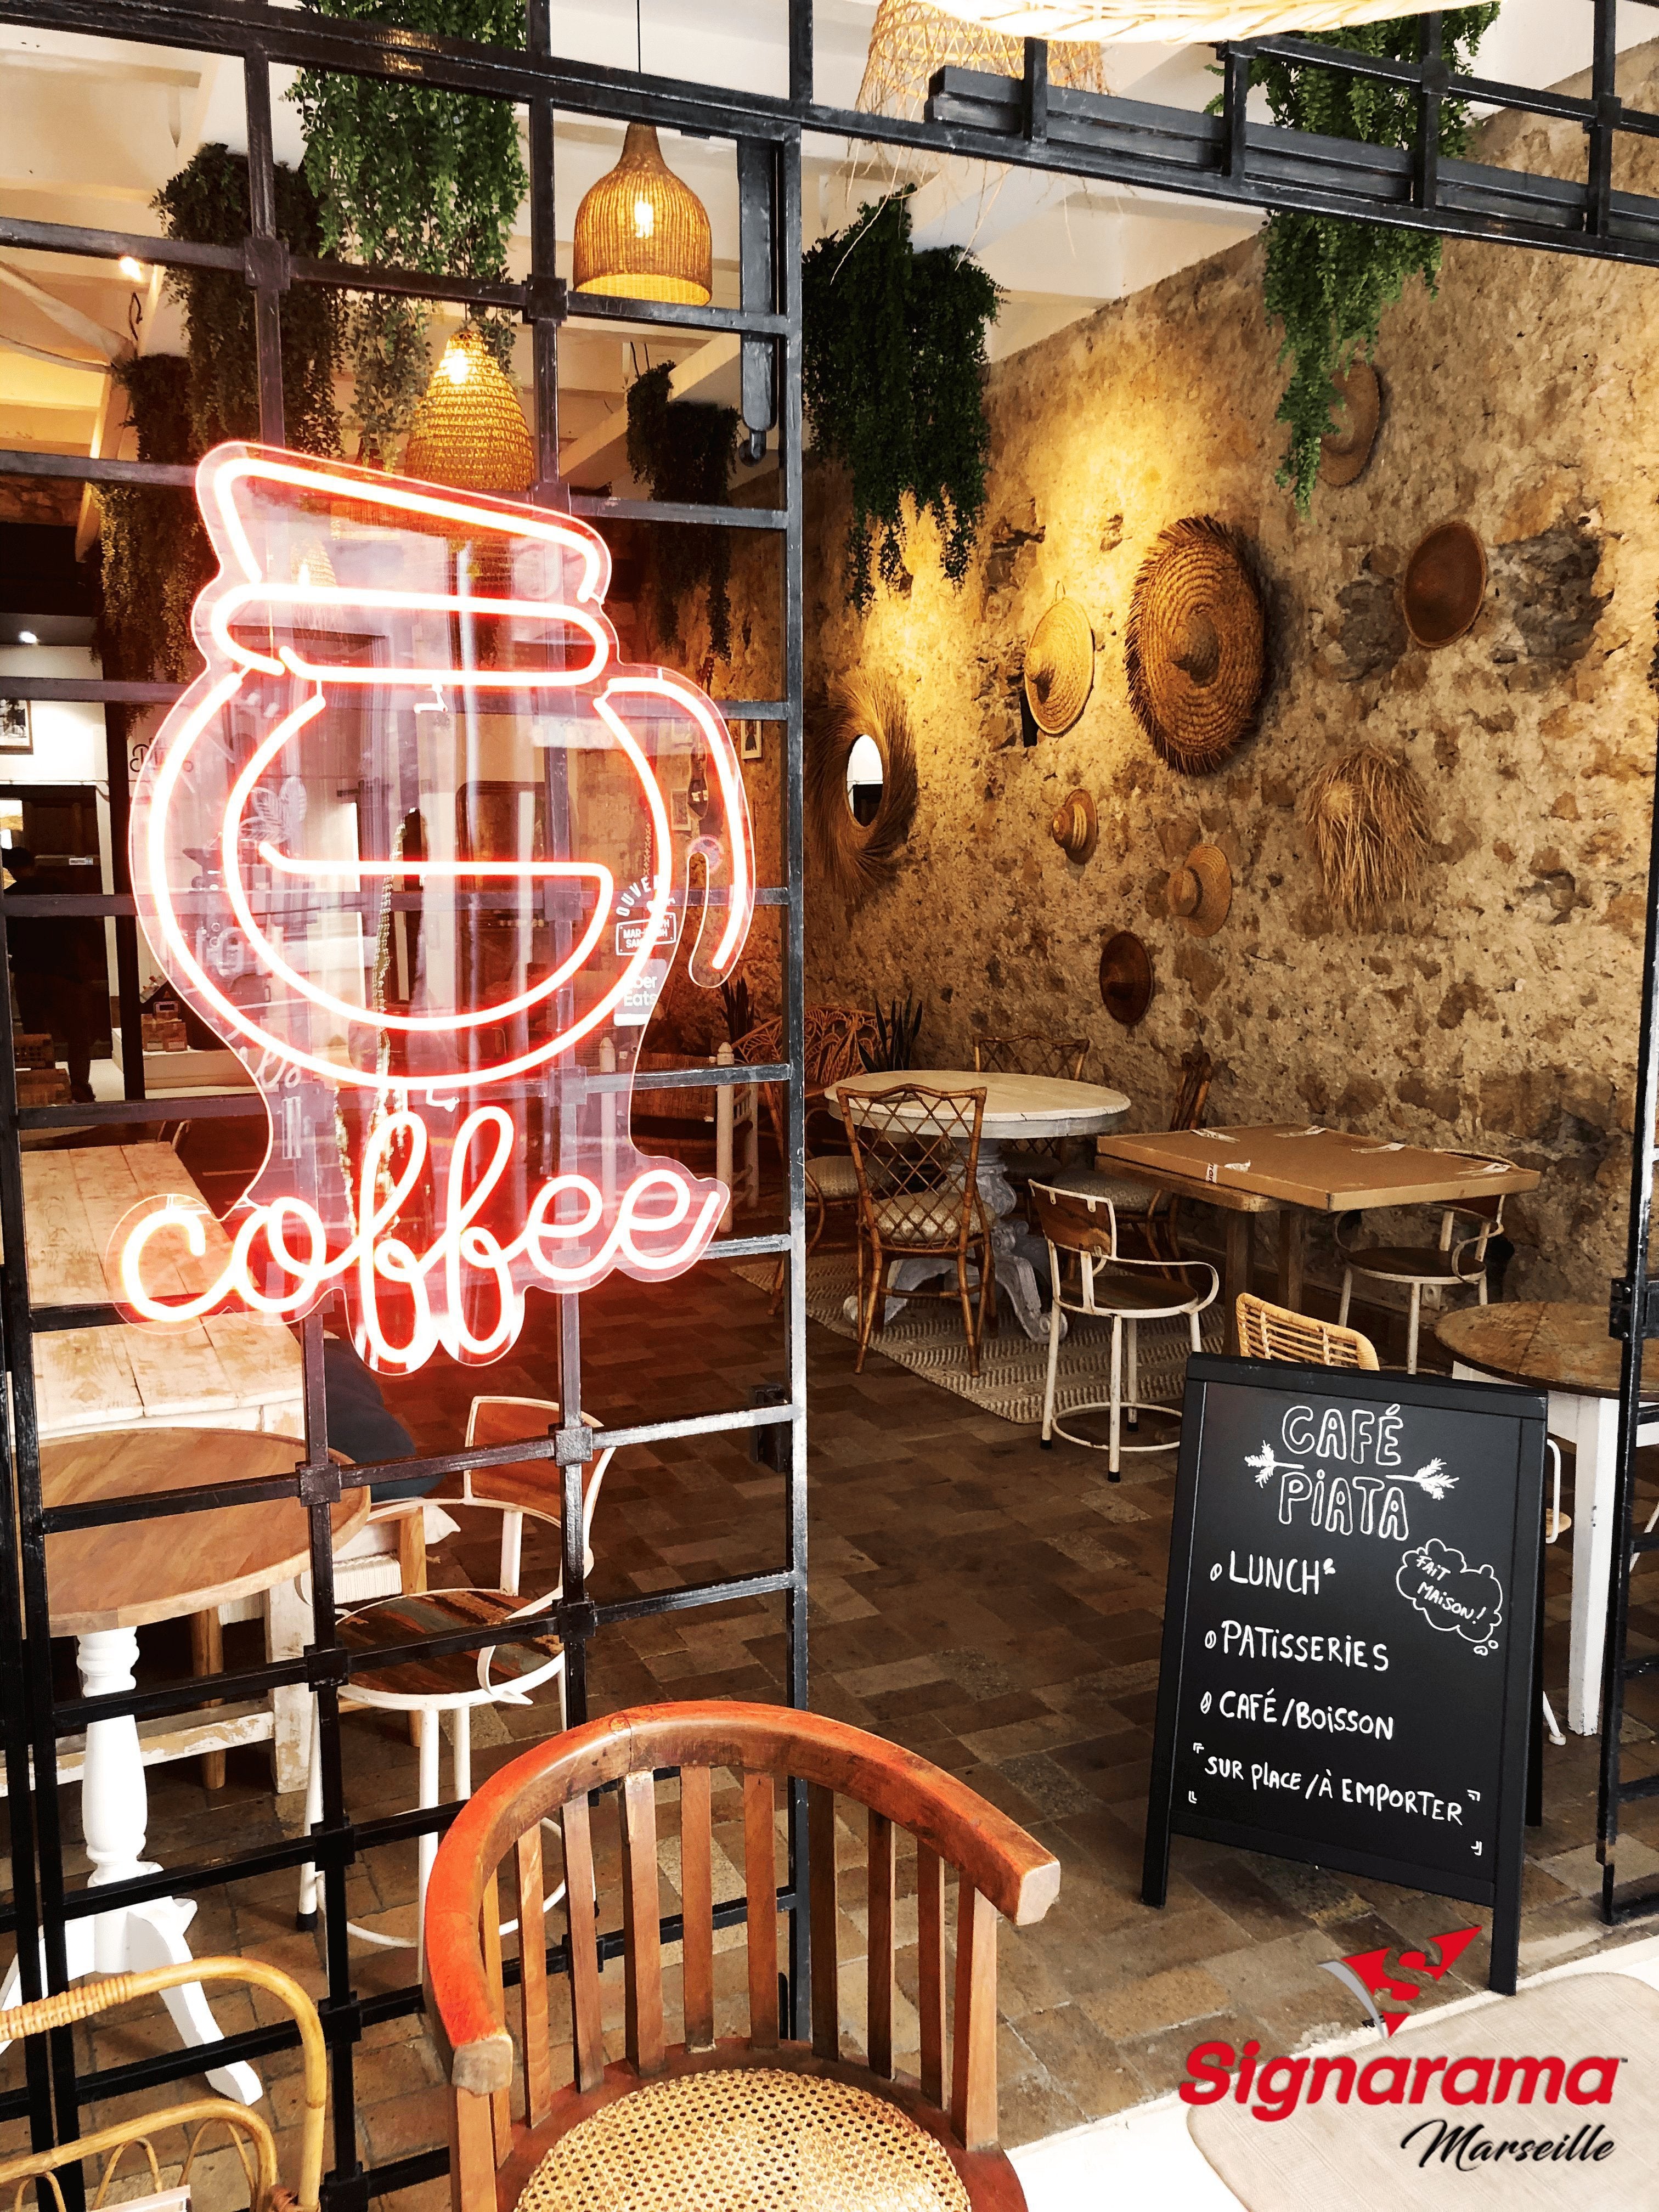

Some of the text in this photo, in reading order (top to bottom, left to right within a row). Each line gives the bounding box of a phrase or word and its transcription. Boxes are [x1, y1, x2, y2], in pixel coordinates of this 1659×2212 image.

[121, 1106, 721, 1364] coffee
[1282, 1403, 1404, 1466] CAFÉ
[1229, 1550, 1319, 1595] LUNCH
[1204, 1756, 1244, 1780] SUR
[1342, 1778, 1463, 1826] EMPORTER
